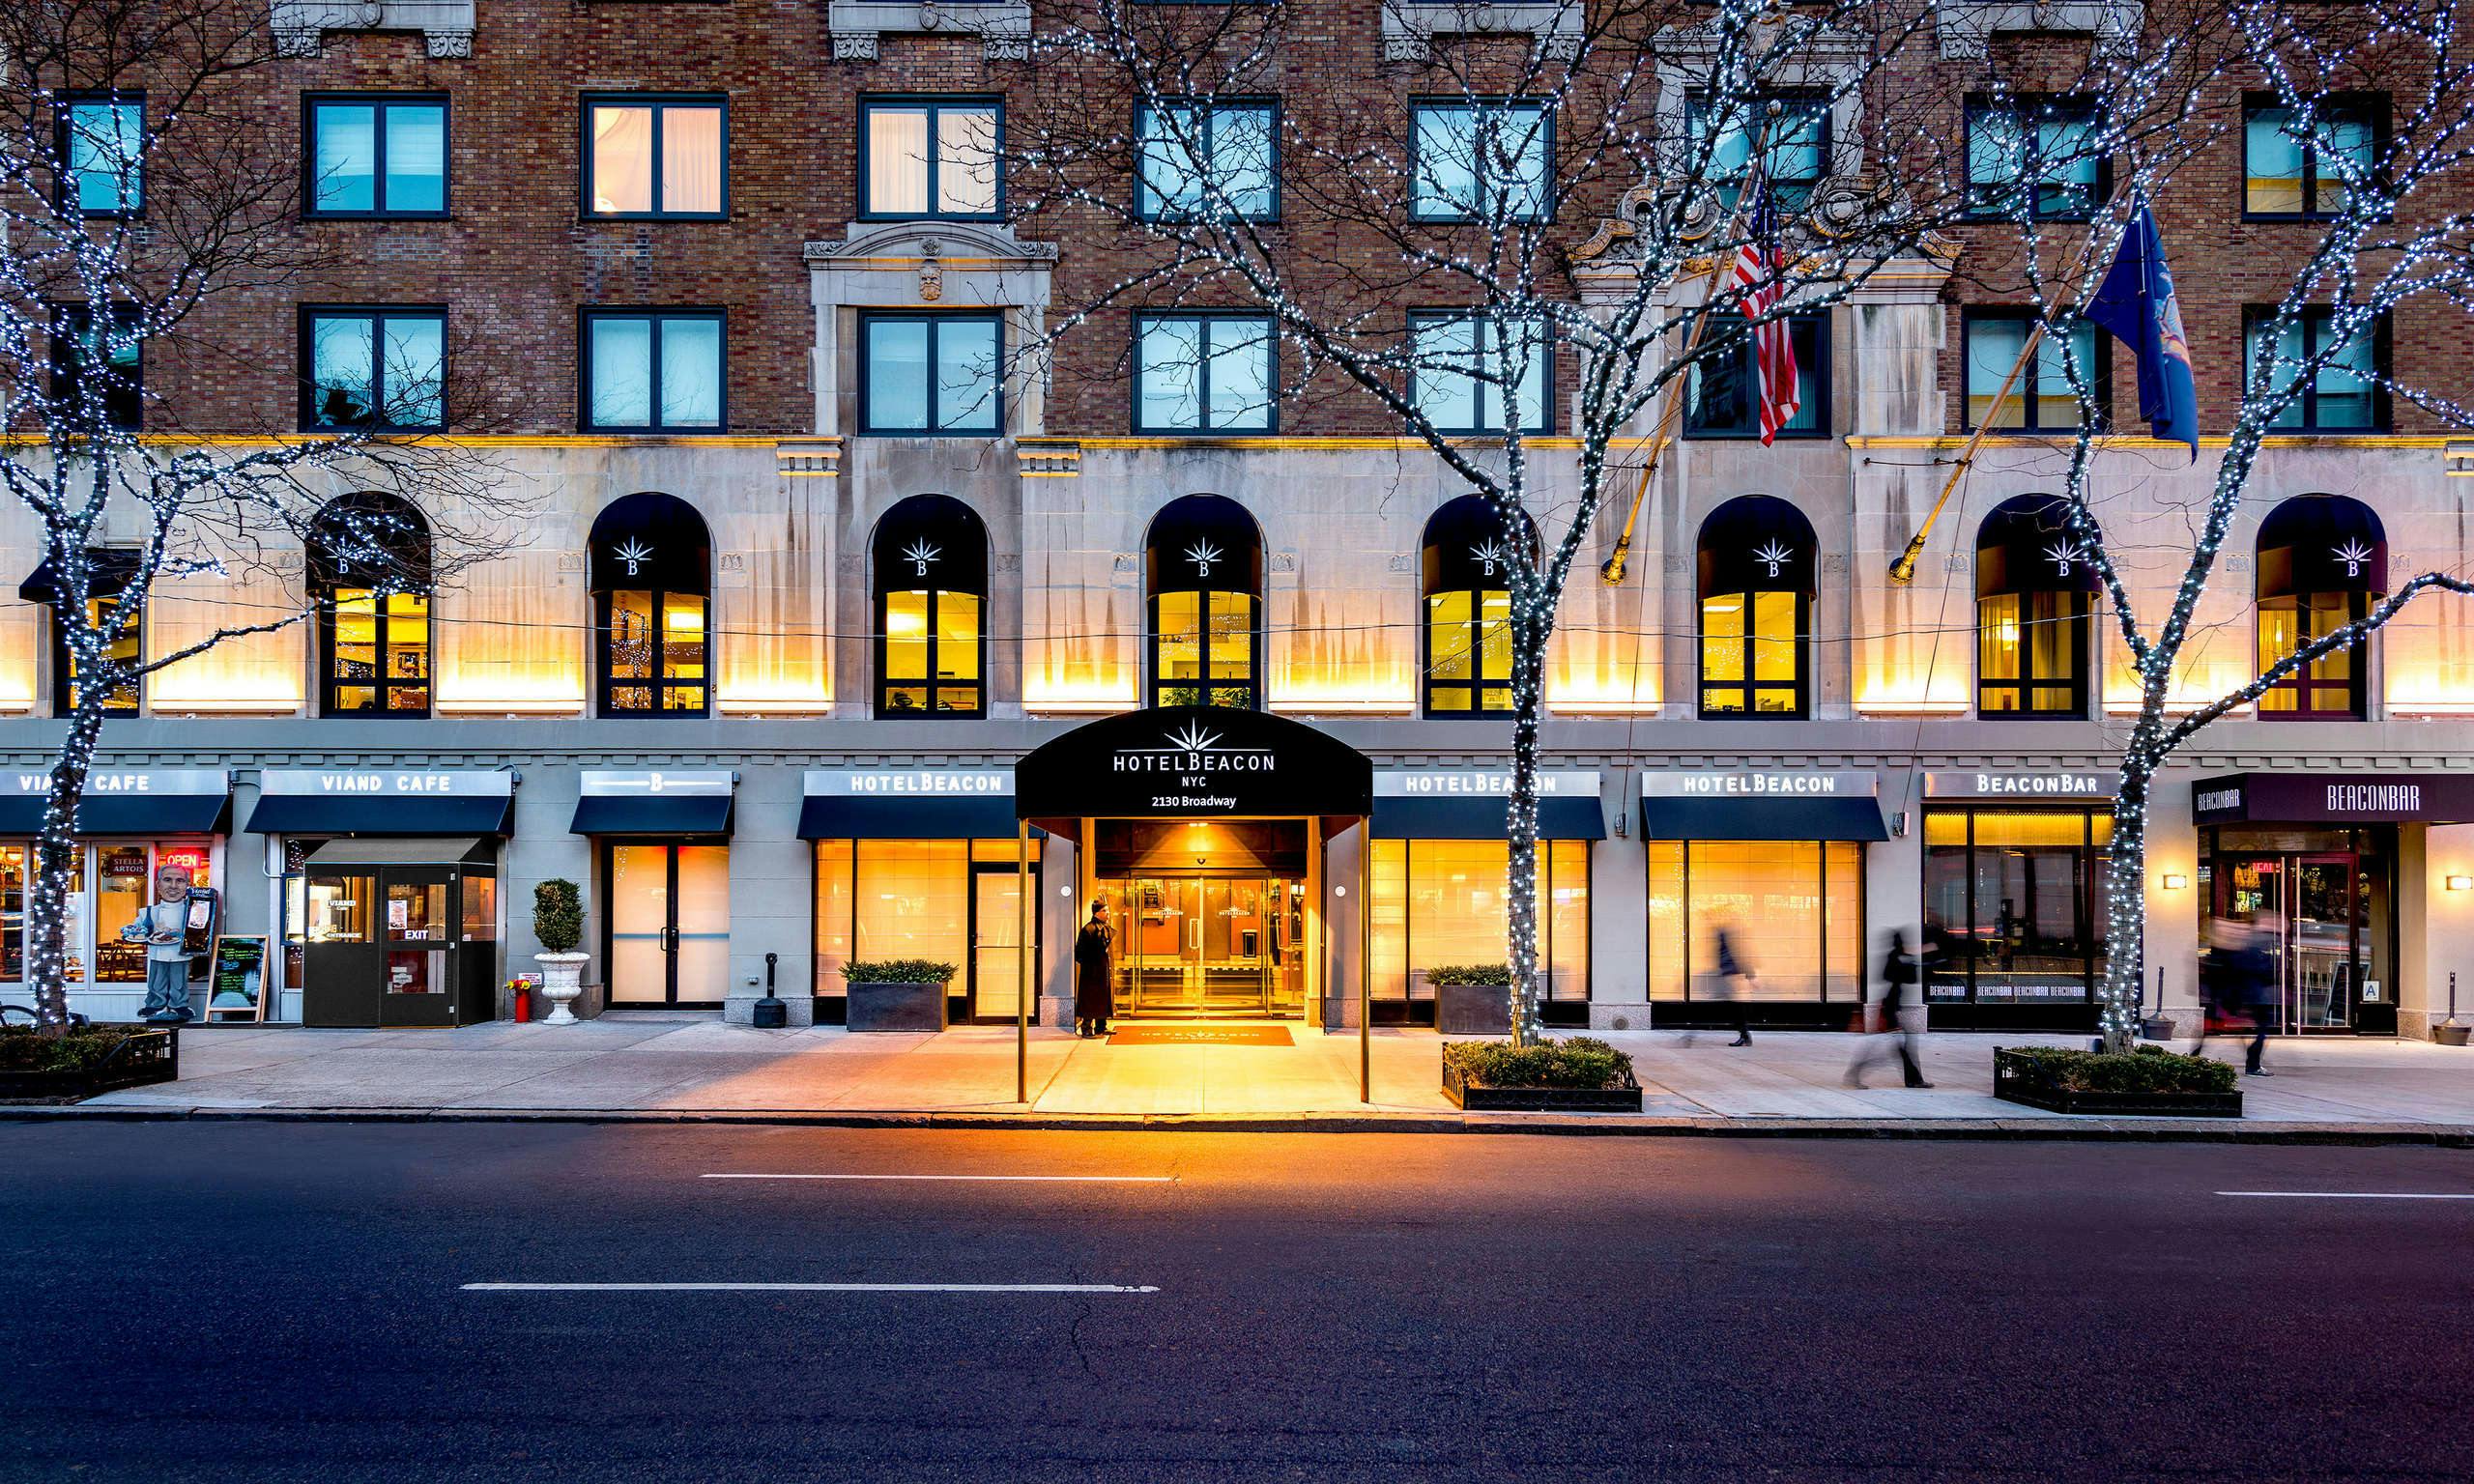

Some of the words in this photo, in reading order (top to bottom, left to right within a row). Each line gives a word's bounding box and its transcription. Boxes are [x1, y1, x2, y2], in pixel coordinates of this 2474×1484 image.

[338, 557, 348, 574] B
[627, 559, 637, 576] B
[916, 560, 926, 577] B
[1198, 560, 1208, 577] B
[1483, 559, 1494, 576] B
[1769, 561, 1778, 578] B
[2058, 560, 2068, 577] B
[2347, 560, 2357, 577] B
[1113, 752, 1275, 771] HOTELBEACON
[95, 775, 149, 791] CAFE
[322, 775, 383, 791] VIAND
[396, 775, 450, 791] CAFE
[648, 773, 664, 791] B
[851, 772, 1001, 791] HOTELBEACON
[1182, 776, 1206, 787] NYC
[1406, 773, 1556, 792] HOTELBEAON
[1684, 773, 1834, 792] HOTELBEACON
[1976, 774, 2097, 792] BEACONBAR
[1151, 796, 1180, 807] 2130
[1182, 795, 1237, 810] Broadway
[2198, 788, 2240, 812] BEACONBAR
[2327, 785, 2420, 812] BEACONBAR
[166, 854, 197, 867] OPEN
[404, 929, 429, 940] EXIT
[1929, 985, 1966, 997] BEACONBAR
[1977, 985, 2013, 997] BEACONBAR
[2014, 985, 2049, 997] BEACONBAR
[2050, 985, 2086, 997] BEACONBAR
[2365, 984, 2376, 997] A
